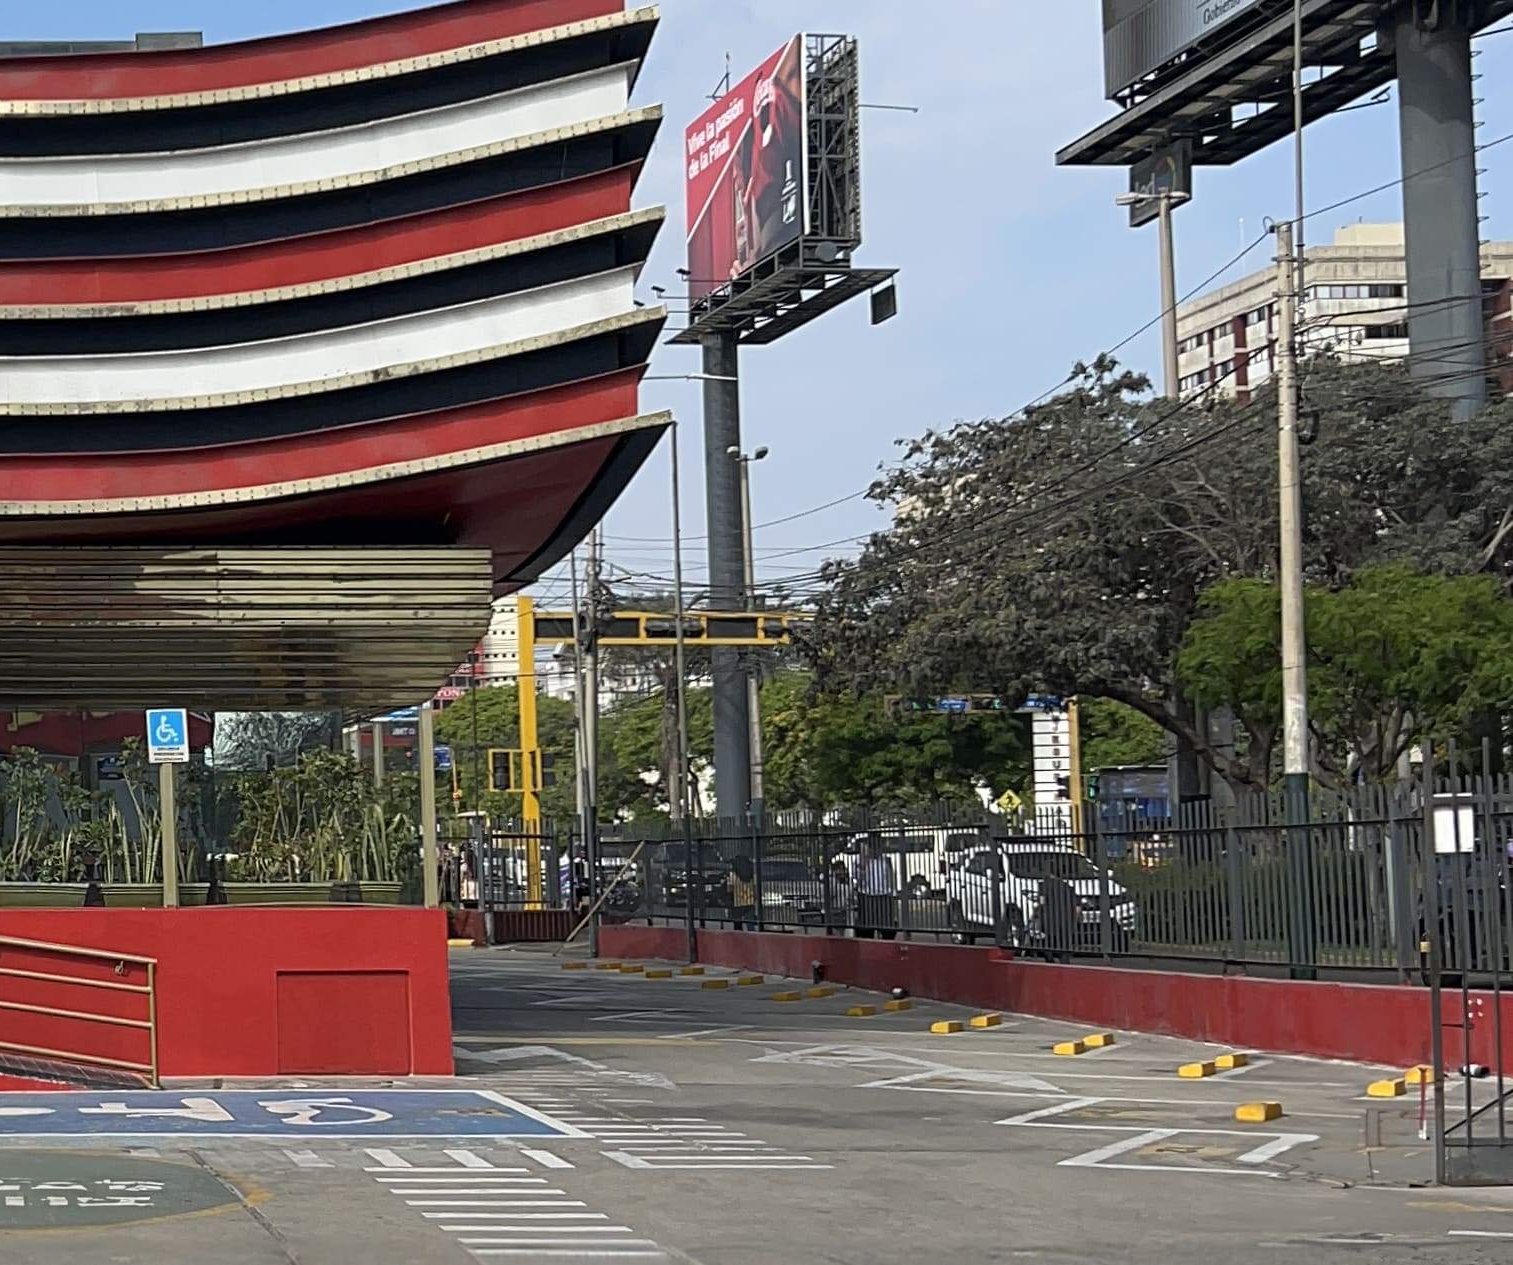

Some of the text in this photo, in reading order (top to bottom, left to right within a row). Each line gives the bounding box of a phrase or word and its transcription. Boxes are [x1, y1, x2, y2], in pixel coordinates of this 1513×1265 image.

[687, 130, 706, 156] Vive
[706, 122, 715, 143] la
[715, 97, 744, 138] pasión
[688, 159, 700, 180] de
[700, 151, 709, 172] la
